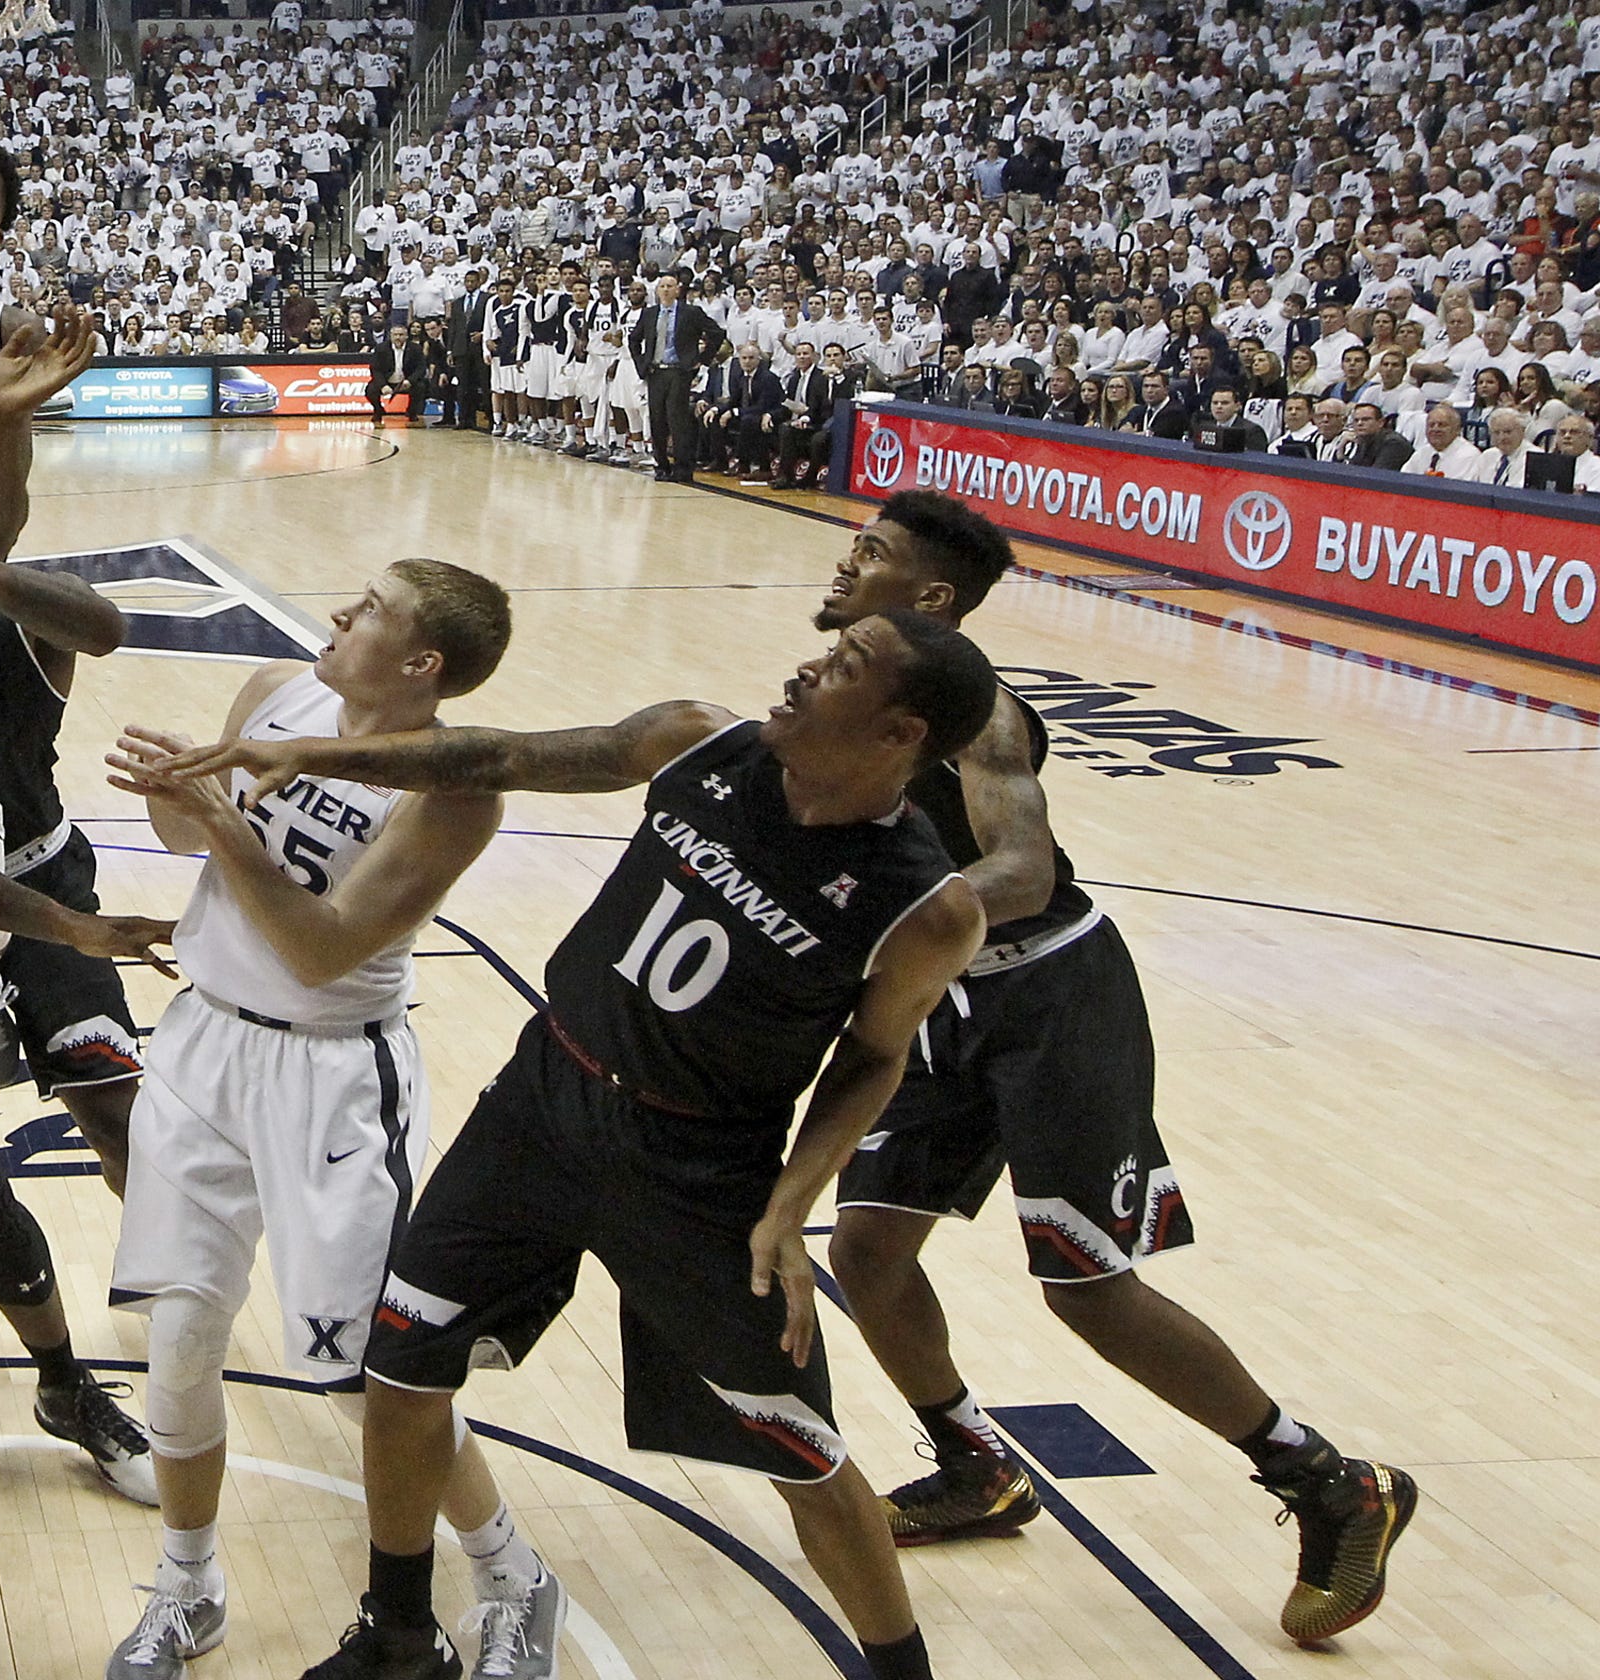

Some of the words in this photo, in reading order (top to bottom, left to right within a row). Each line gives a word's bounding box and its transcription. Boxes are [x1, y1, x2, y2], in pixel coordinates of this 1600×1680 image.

[80, 384, 209, 402] PRIUS
[133, 371, 173, 380] TOYOTA
[284, 379, 368, 397] CAM
[915, 445, 1202, 544] BUYATOYOTA.COM
[1315, 515, 1598, 625] BUYATOYO
[276, 778, 375, 844] VIER
[652, 811, 822, 958] CINCINNATI
[612, 878, 730, 1013] 10
